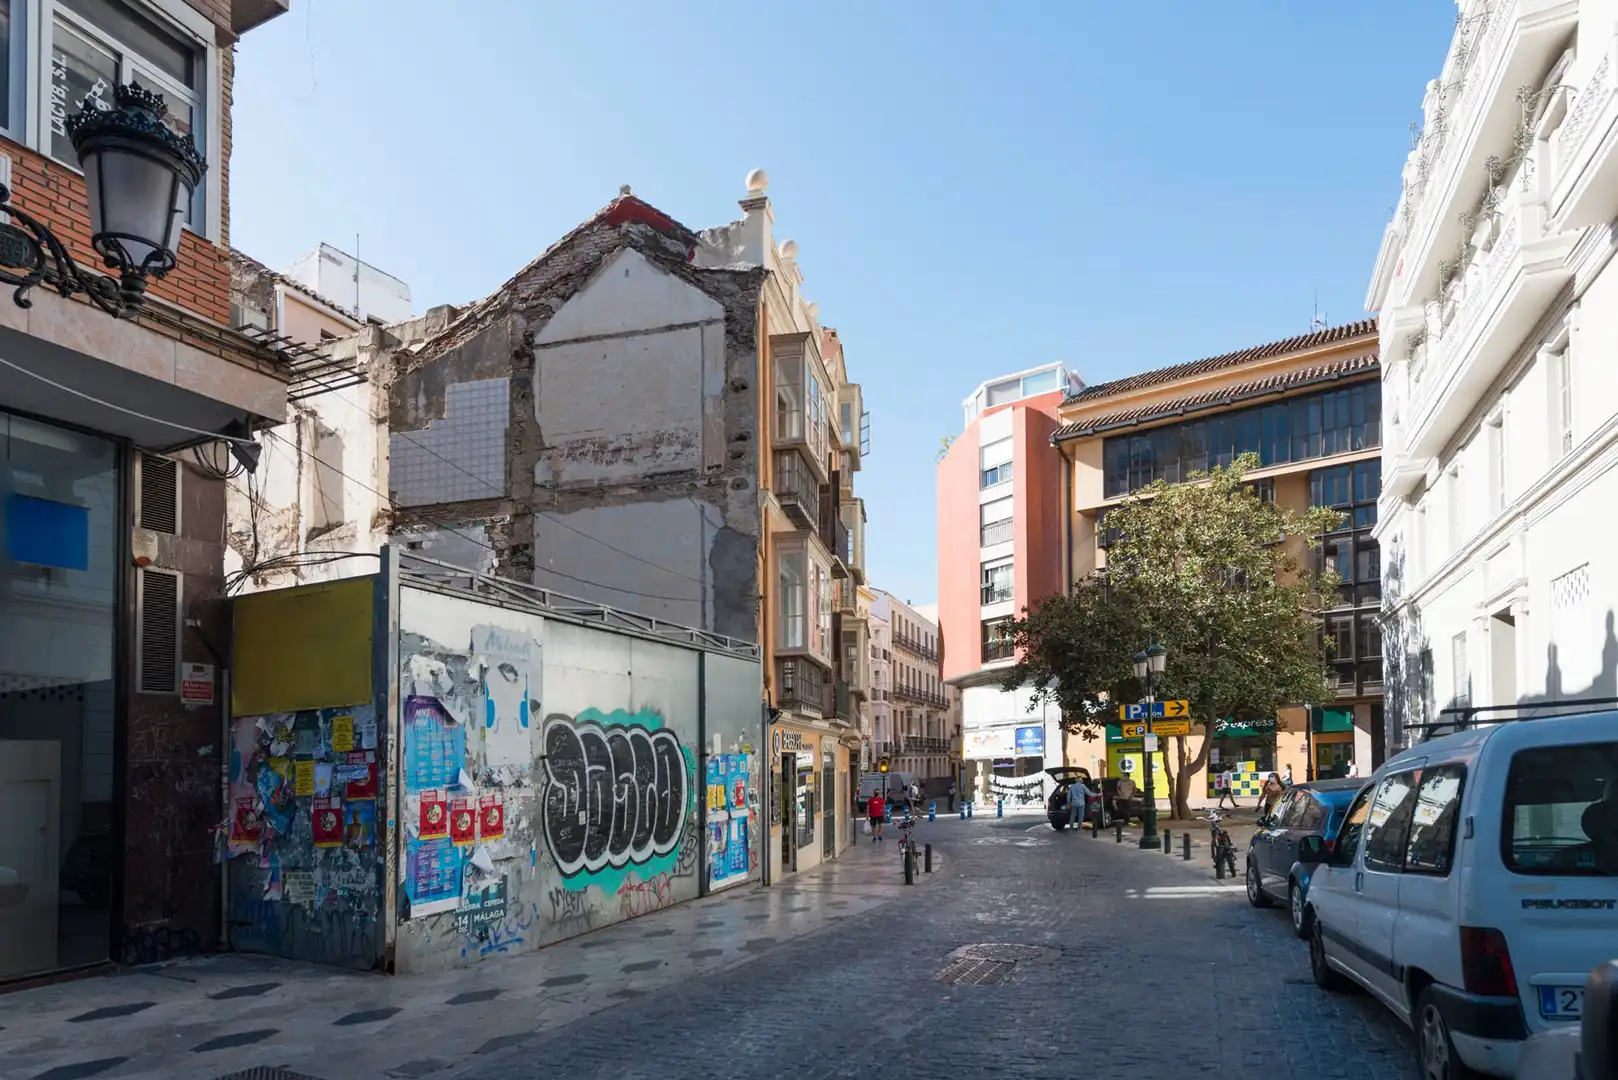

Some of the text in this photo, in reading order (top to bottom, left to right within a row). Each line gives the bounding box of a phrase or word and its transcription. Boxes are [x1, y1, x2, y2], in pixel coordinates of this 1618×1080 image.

[1130, 705, 1142, 719] P
[1230, 719, 1274, 729] express
[484, 898, 504, 908] CEPEDA
[1521, 898, 1617, 910] PEUGEOT
[457, 915, 469, 927] 14
[474, 909, 504, 922] MÁLAGA
